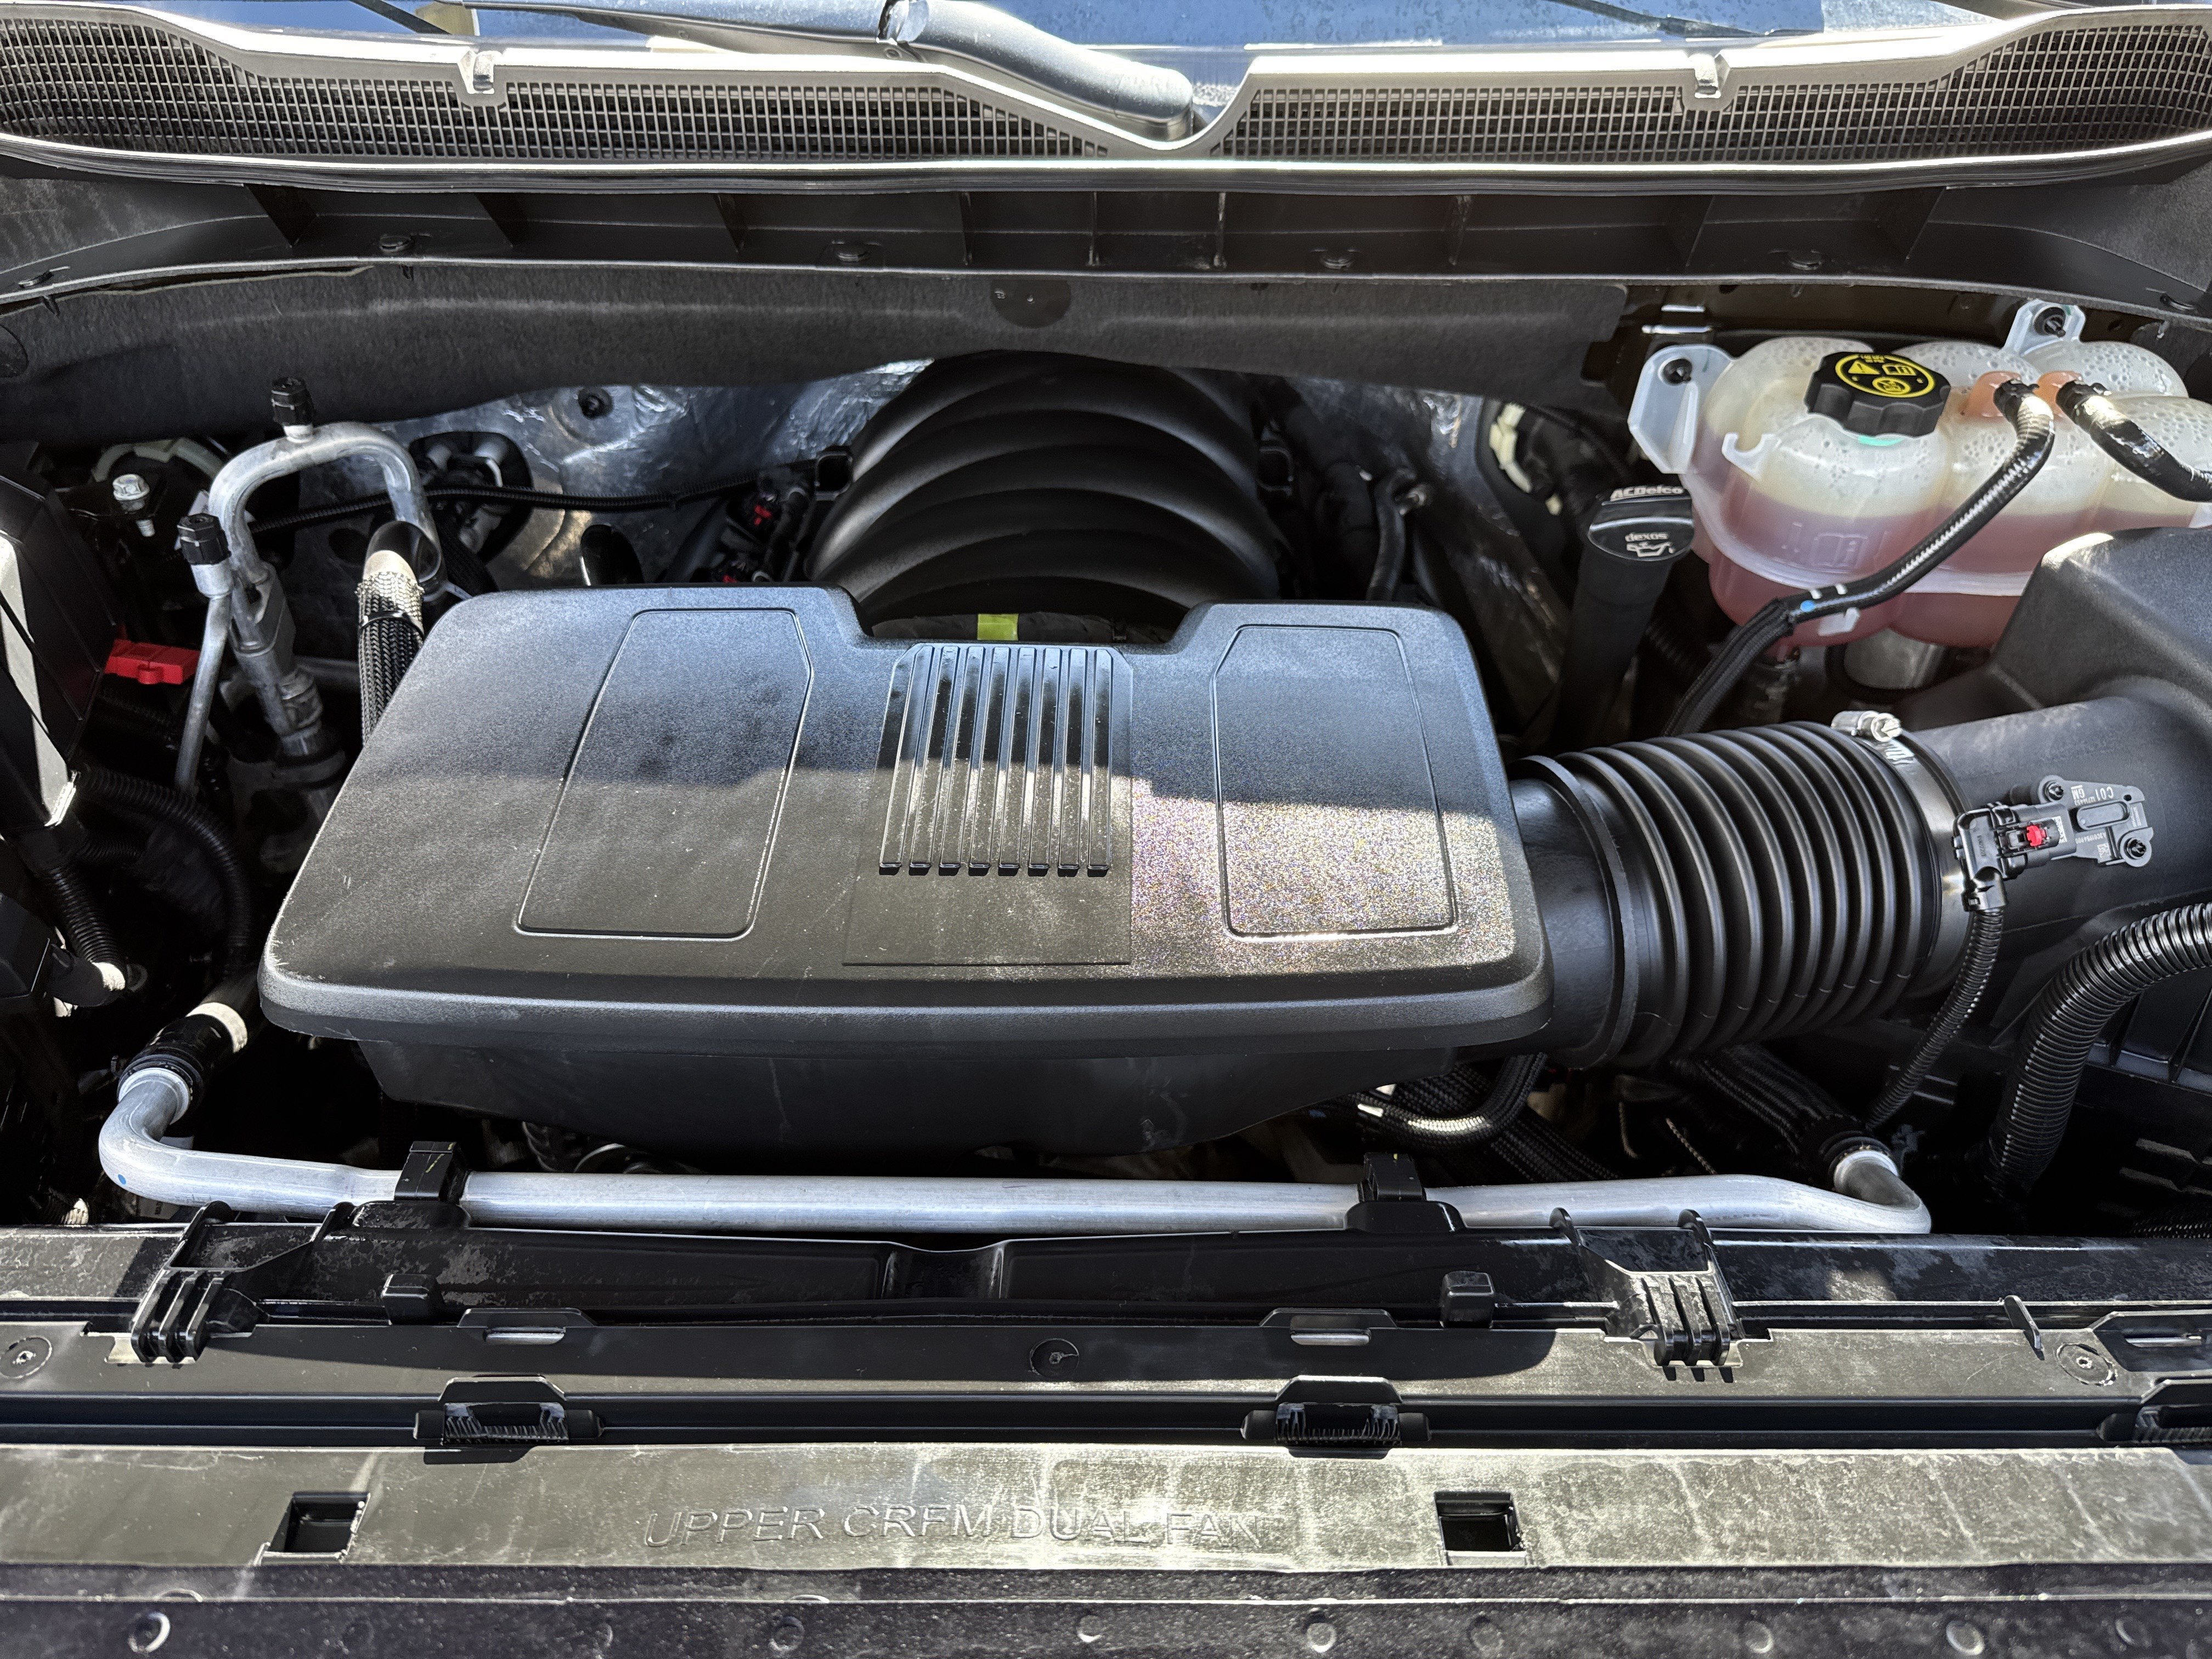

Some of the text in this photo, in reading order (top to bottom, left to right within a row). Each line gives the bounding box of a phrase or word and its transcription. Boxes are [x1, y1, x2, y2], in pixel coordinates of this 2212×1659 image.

[1609, 484, 1684, 501] ACDelco
[1624, 532, 1668, 542] dexos
[2072, 787, 2085, 800] GM
[643, 1503, 1265, 1550] UPPER CRFM DUAL FAN
